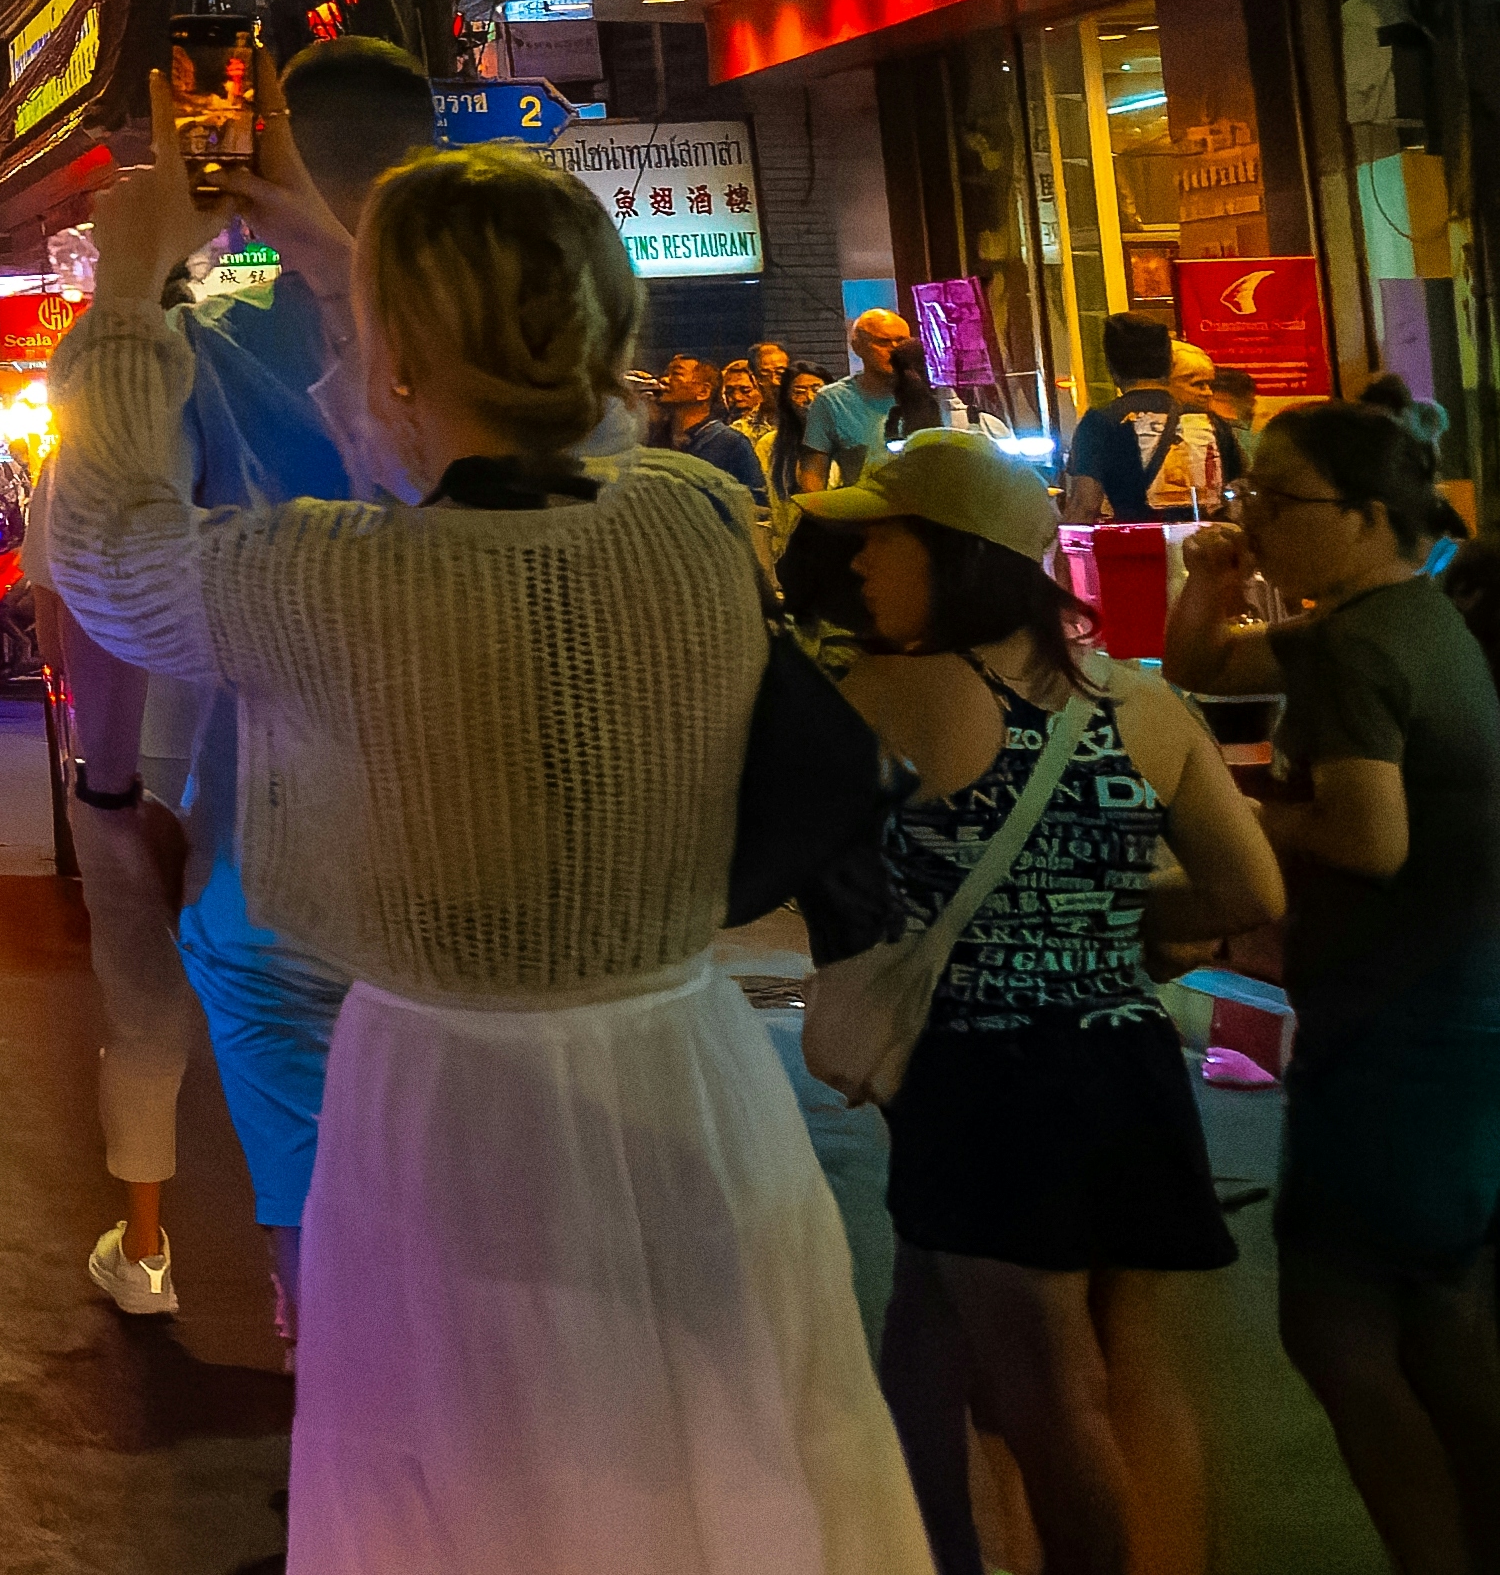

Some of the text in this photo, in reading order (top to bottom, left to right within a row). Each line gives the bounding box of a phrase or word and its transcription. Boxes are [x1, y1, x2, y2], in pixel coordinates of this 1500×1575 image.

[519, 95, 542, 127] 2
[613, 183, 752, 219] 魚翅酒樓
[662, 231, 757, 260] RESTAURANT
[4, 333, 53, 348] Scala
